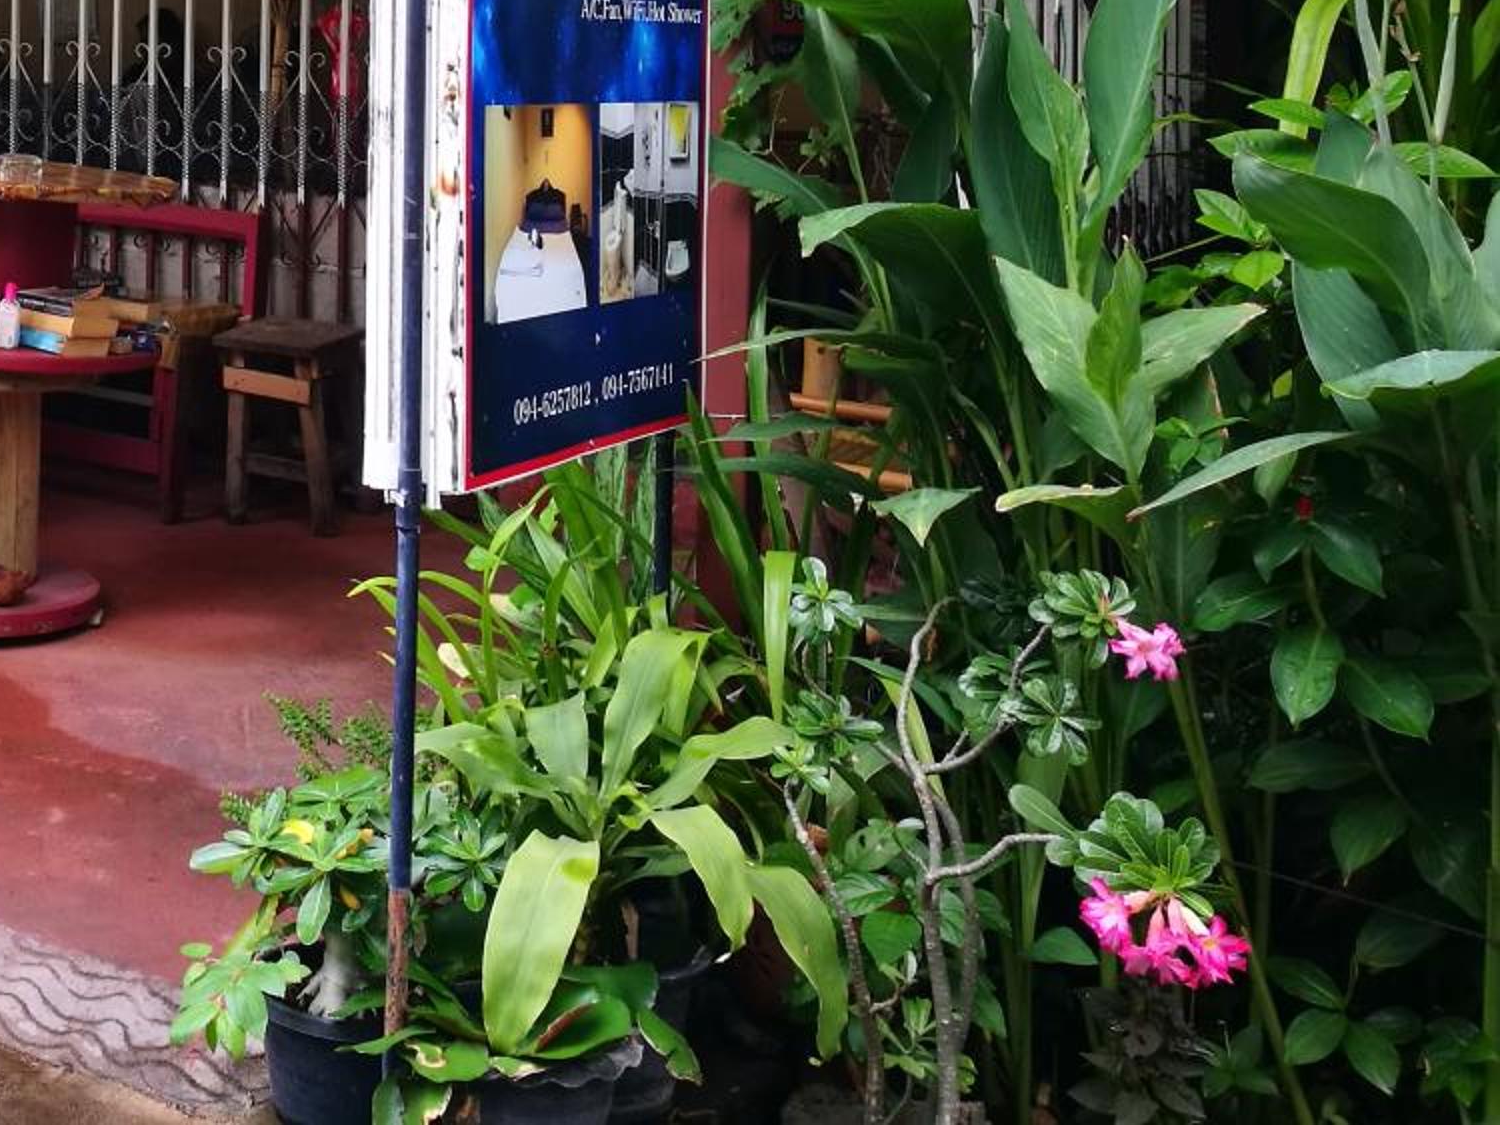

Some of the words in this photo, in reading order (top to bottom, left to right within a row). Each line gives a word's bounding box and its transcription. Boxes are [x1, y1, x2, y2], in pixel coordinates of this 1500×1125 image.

[667, 2, 702, 24] Shower
[513, 381, 591, 425] 094-6257812
[601, 362, 673, 401] 094-7567141
